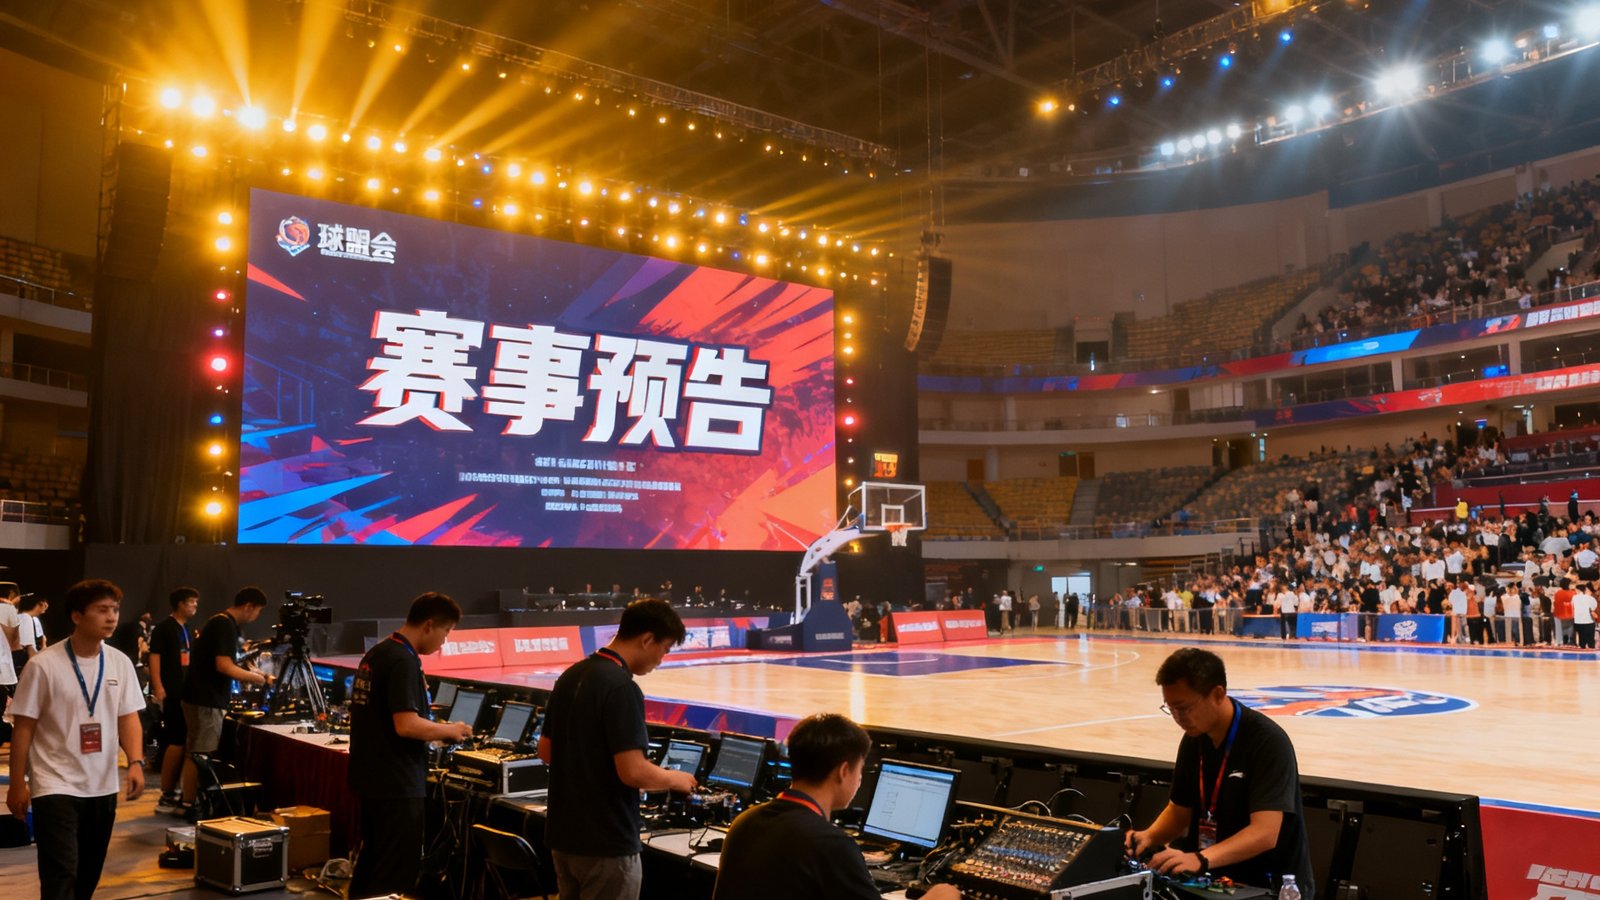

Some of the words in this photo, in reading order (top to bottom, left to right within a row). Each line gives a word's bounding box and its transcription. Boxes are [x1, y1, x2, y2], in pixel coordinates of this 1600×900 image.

[317, 223, 396, 259] 球盟会
[356, 309, 770, 451] 赛事预告
